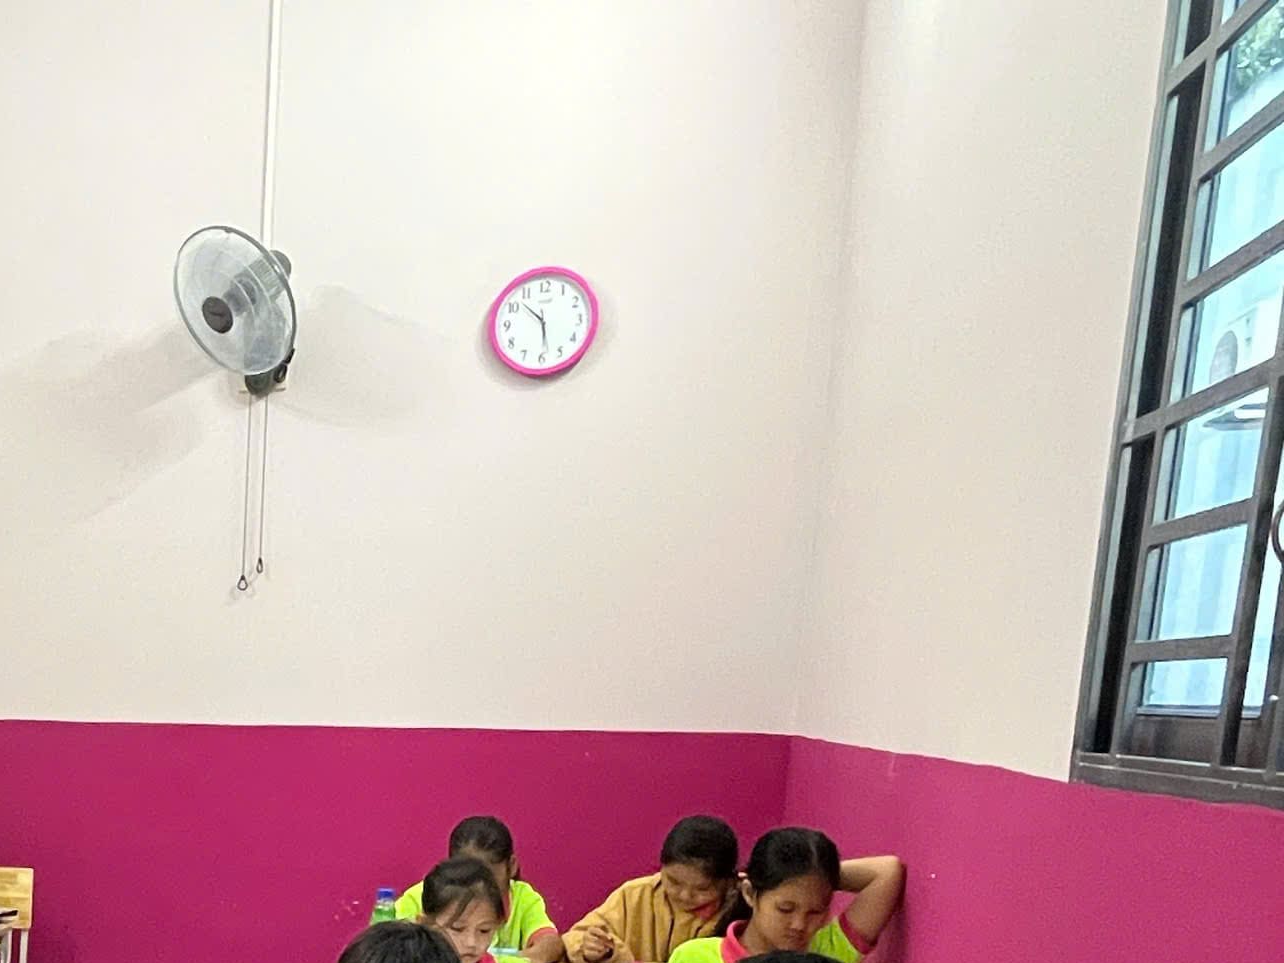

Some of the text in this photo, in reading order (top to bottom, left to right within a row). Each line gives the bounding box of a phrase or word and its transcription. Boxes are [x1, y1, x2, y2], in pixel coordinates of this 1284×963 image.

[539, 280, 551, 293] 12
[560, 284, 565, 296] 1
[522, 287, 531, 299] 11
[507, 302, 520, 314] 10
[572, 296, 579, 308] 2
[575, 313, 582, 326] 3
[503, 320, 511, 332] 9
[507, 337, 515, 349] 8
[569, 332, 576, 343] 4
[520, 349, 527, 361] 7
[556, 346, 563, 358] 5
[537, 352, 545, 365] 6
